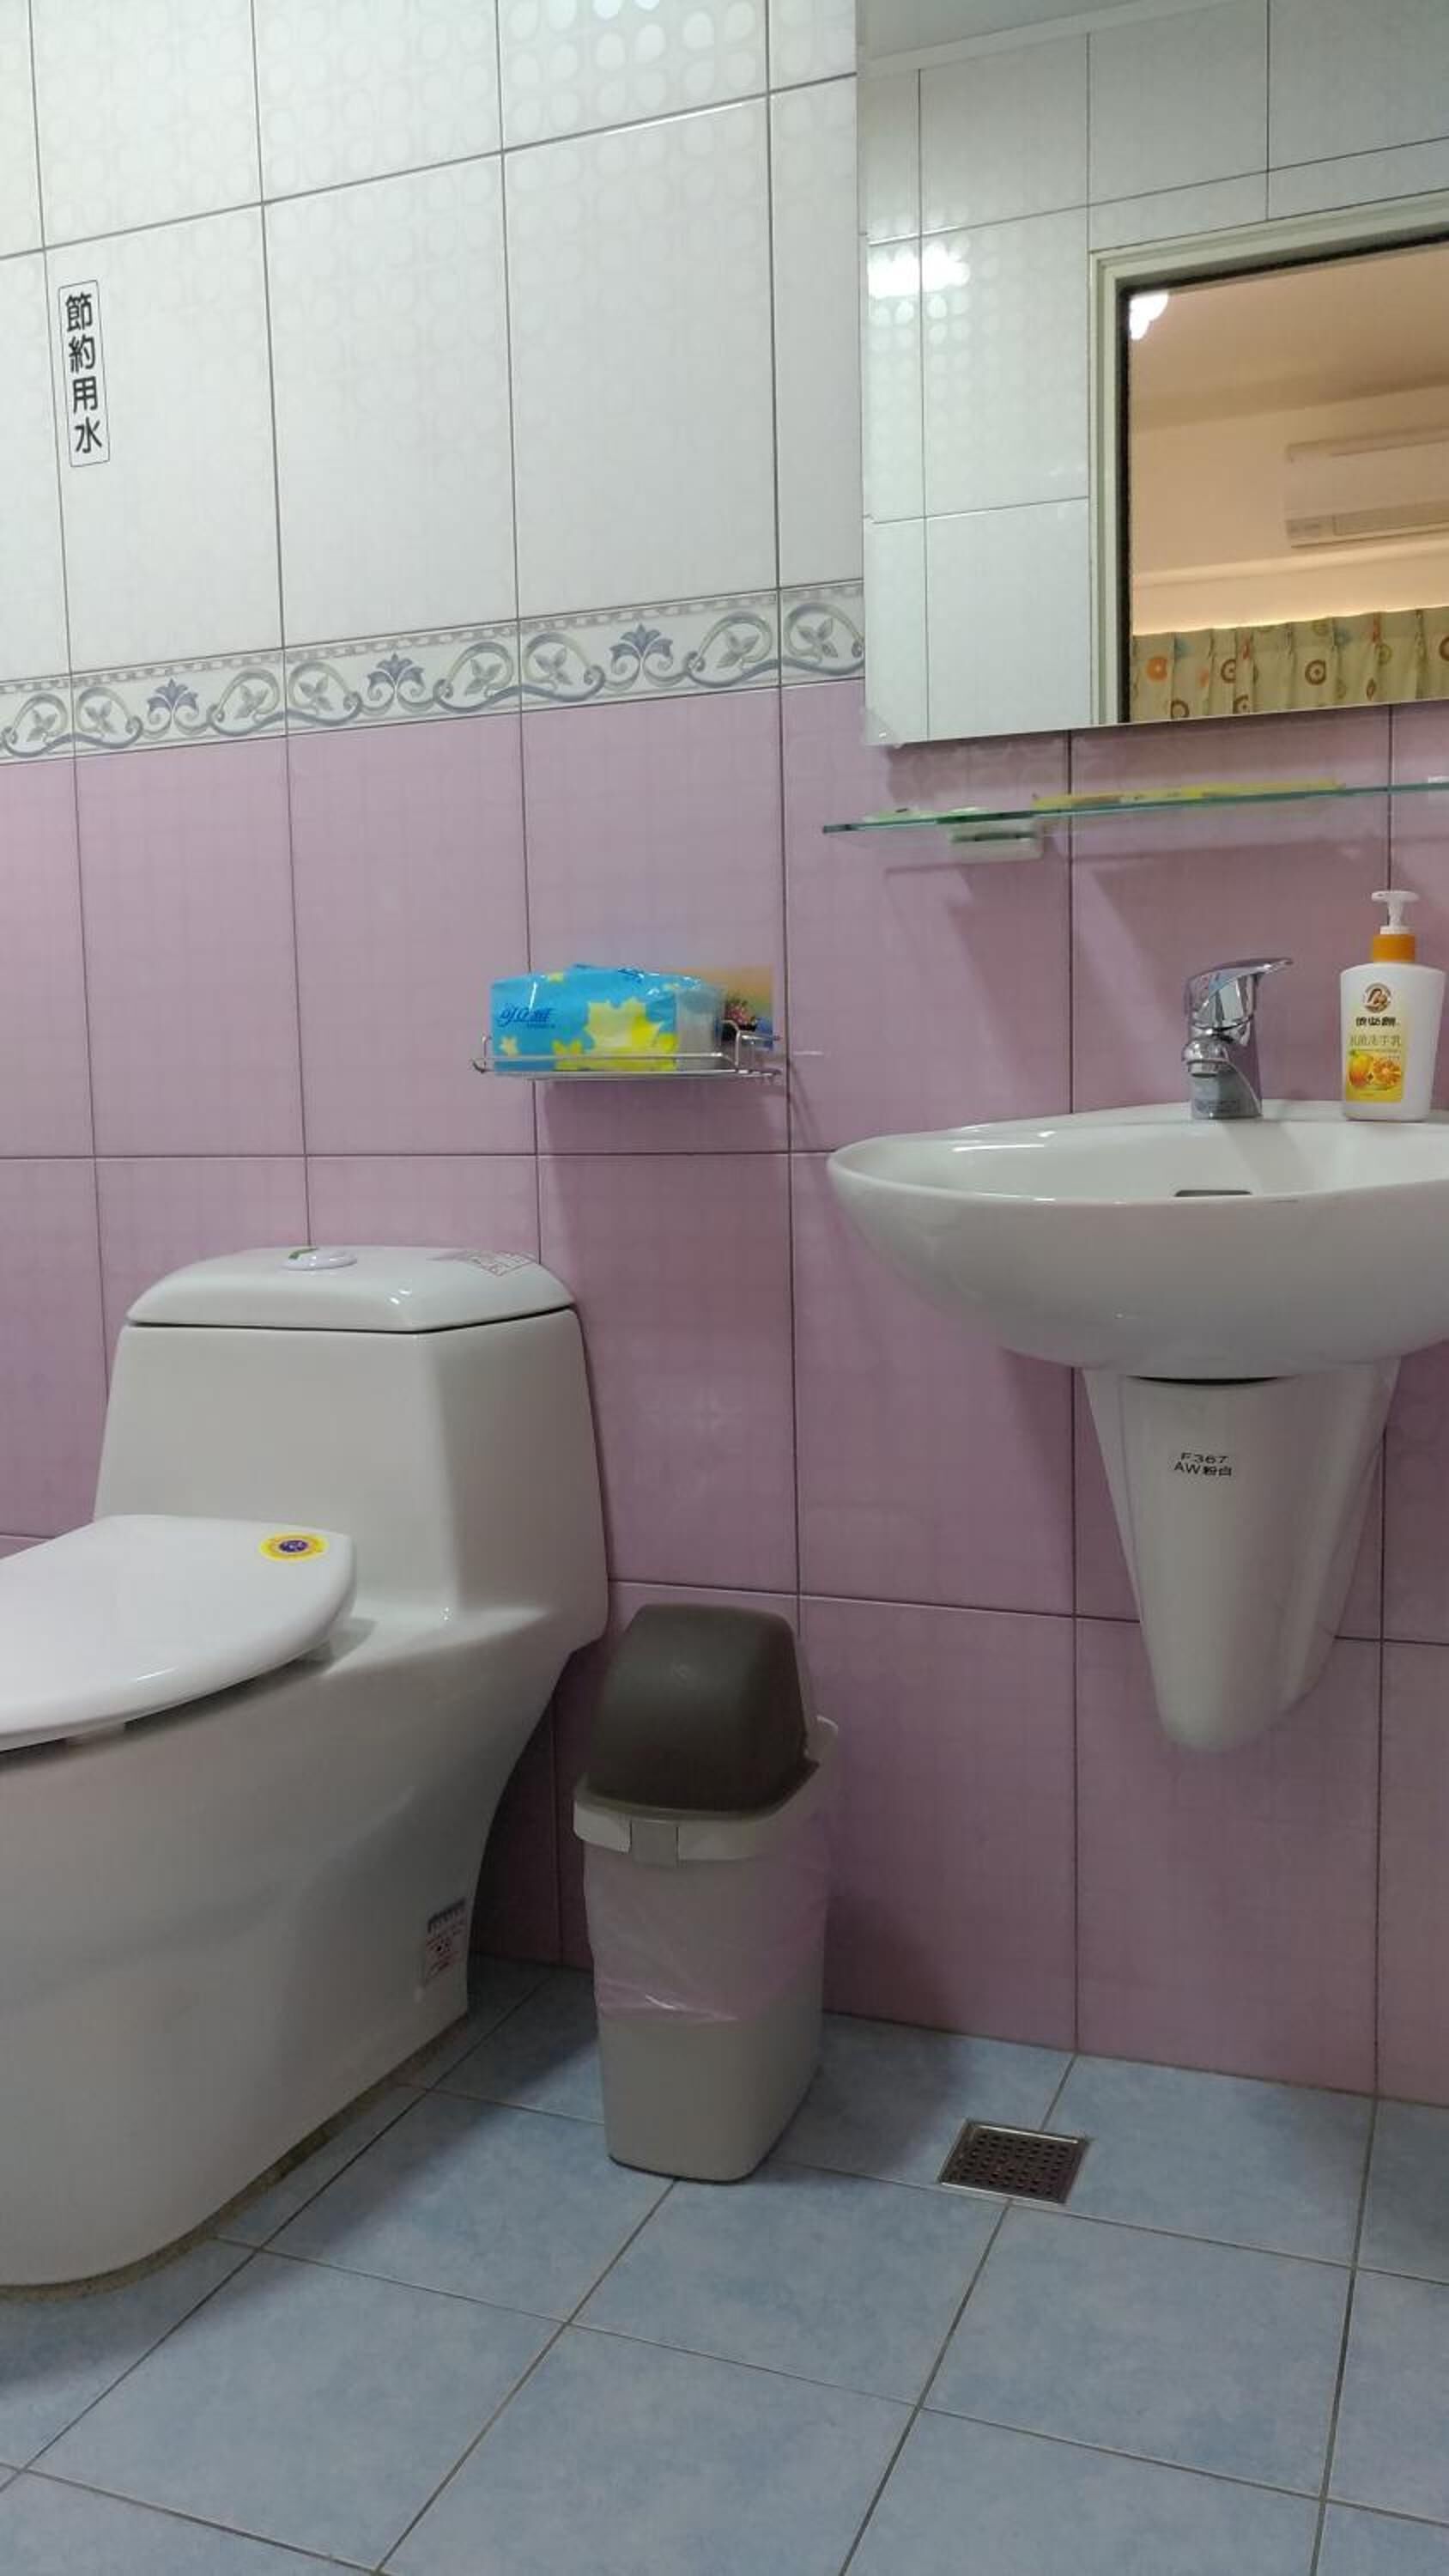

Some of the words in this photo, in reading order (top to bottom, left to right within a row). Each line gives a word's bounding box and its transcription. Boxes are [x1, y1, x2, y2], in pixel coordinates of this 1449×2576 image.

[65, 292, 102, 453] 節約用水
[1180, 1452, 1228, 1463] F367
